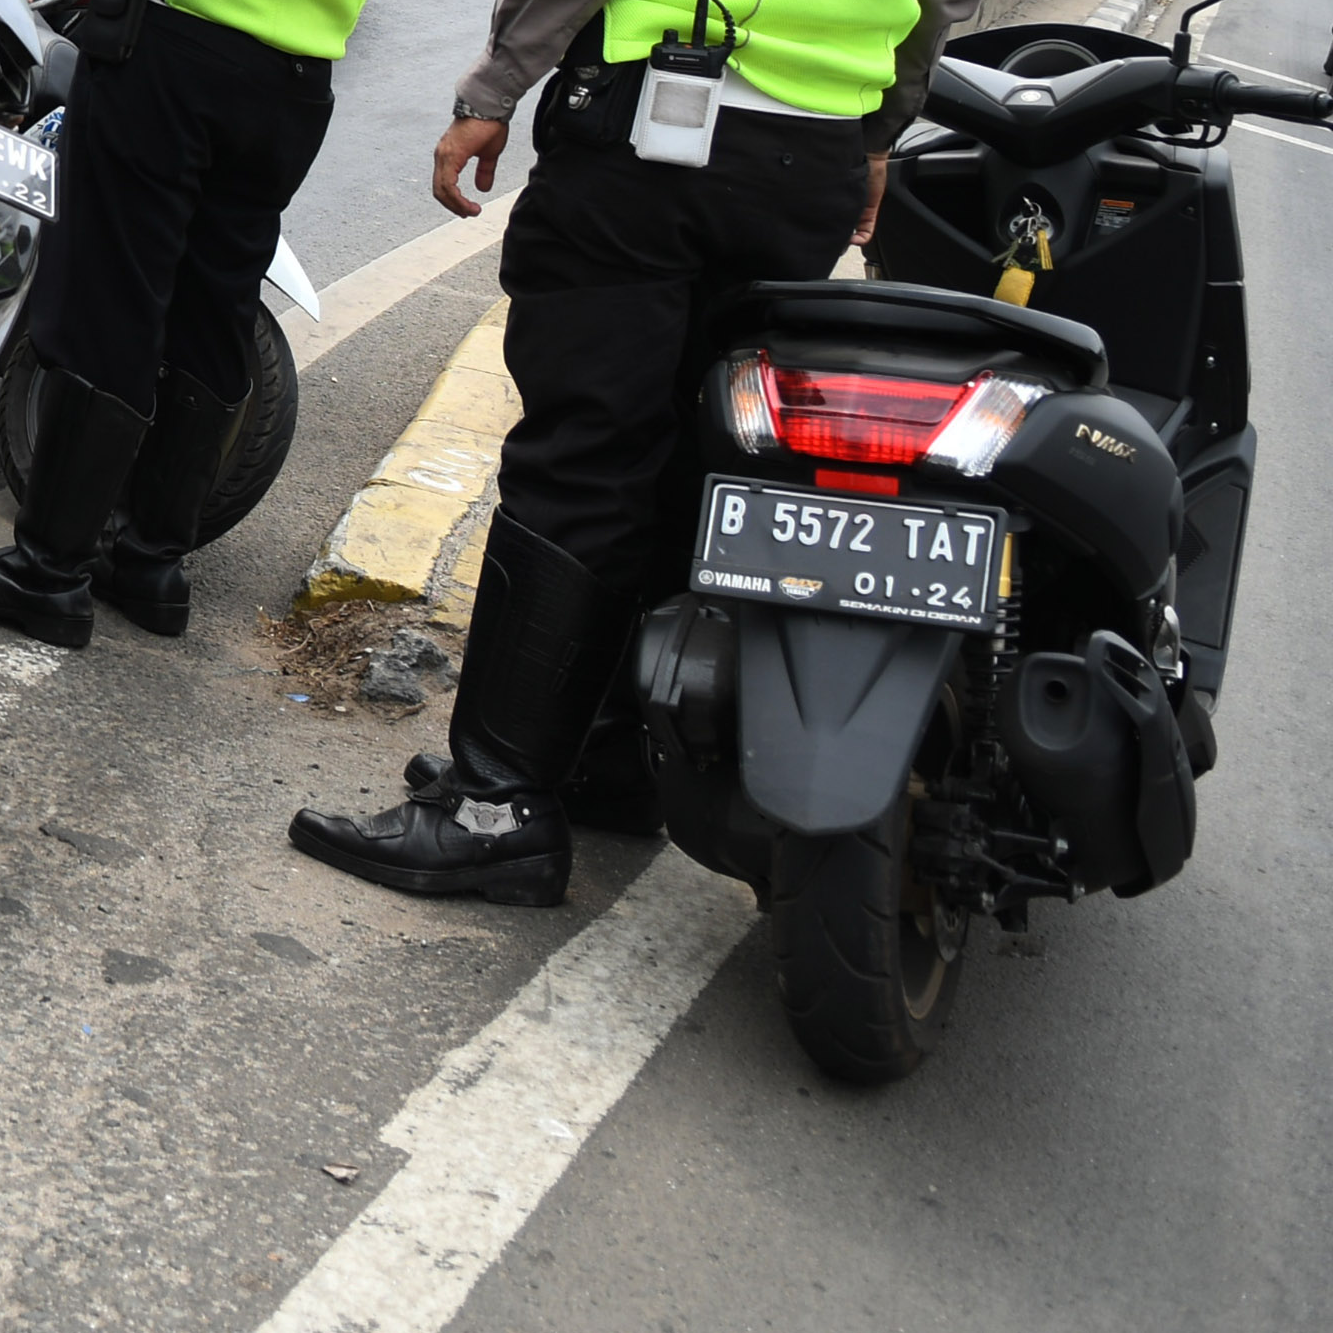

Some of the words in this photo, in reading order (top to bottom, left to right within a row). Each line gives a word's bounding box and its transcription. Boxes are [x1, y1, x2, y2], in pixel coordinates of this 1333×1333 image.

[720, 494, 747, 535] B
[771, 501, 875, 553] 5572
[902, 517, 986, 567] TAT
[715, 571, 771, 593] YAMAHA
